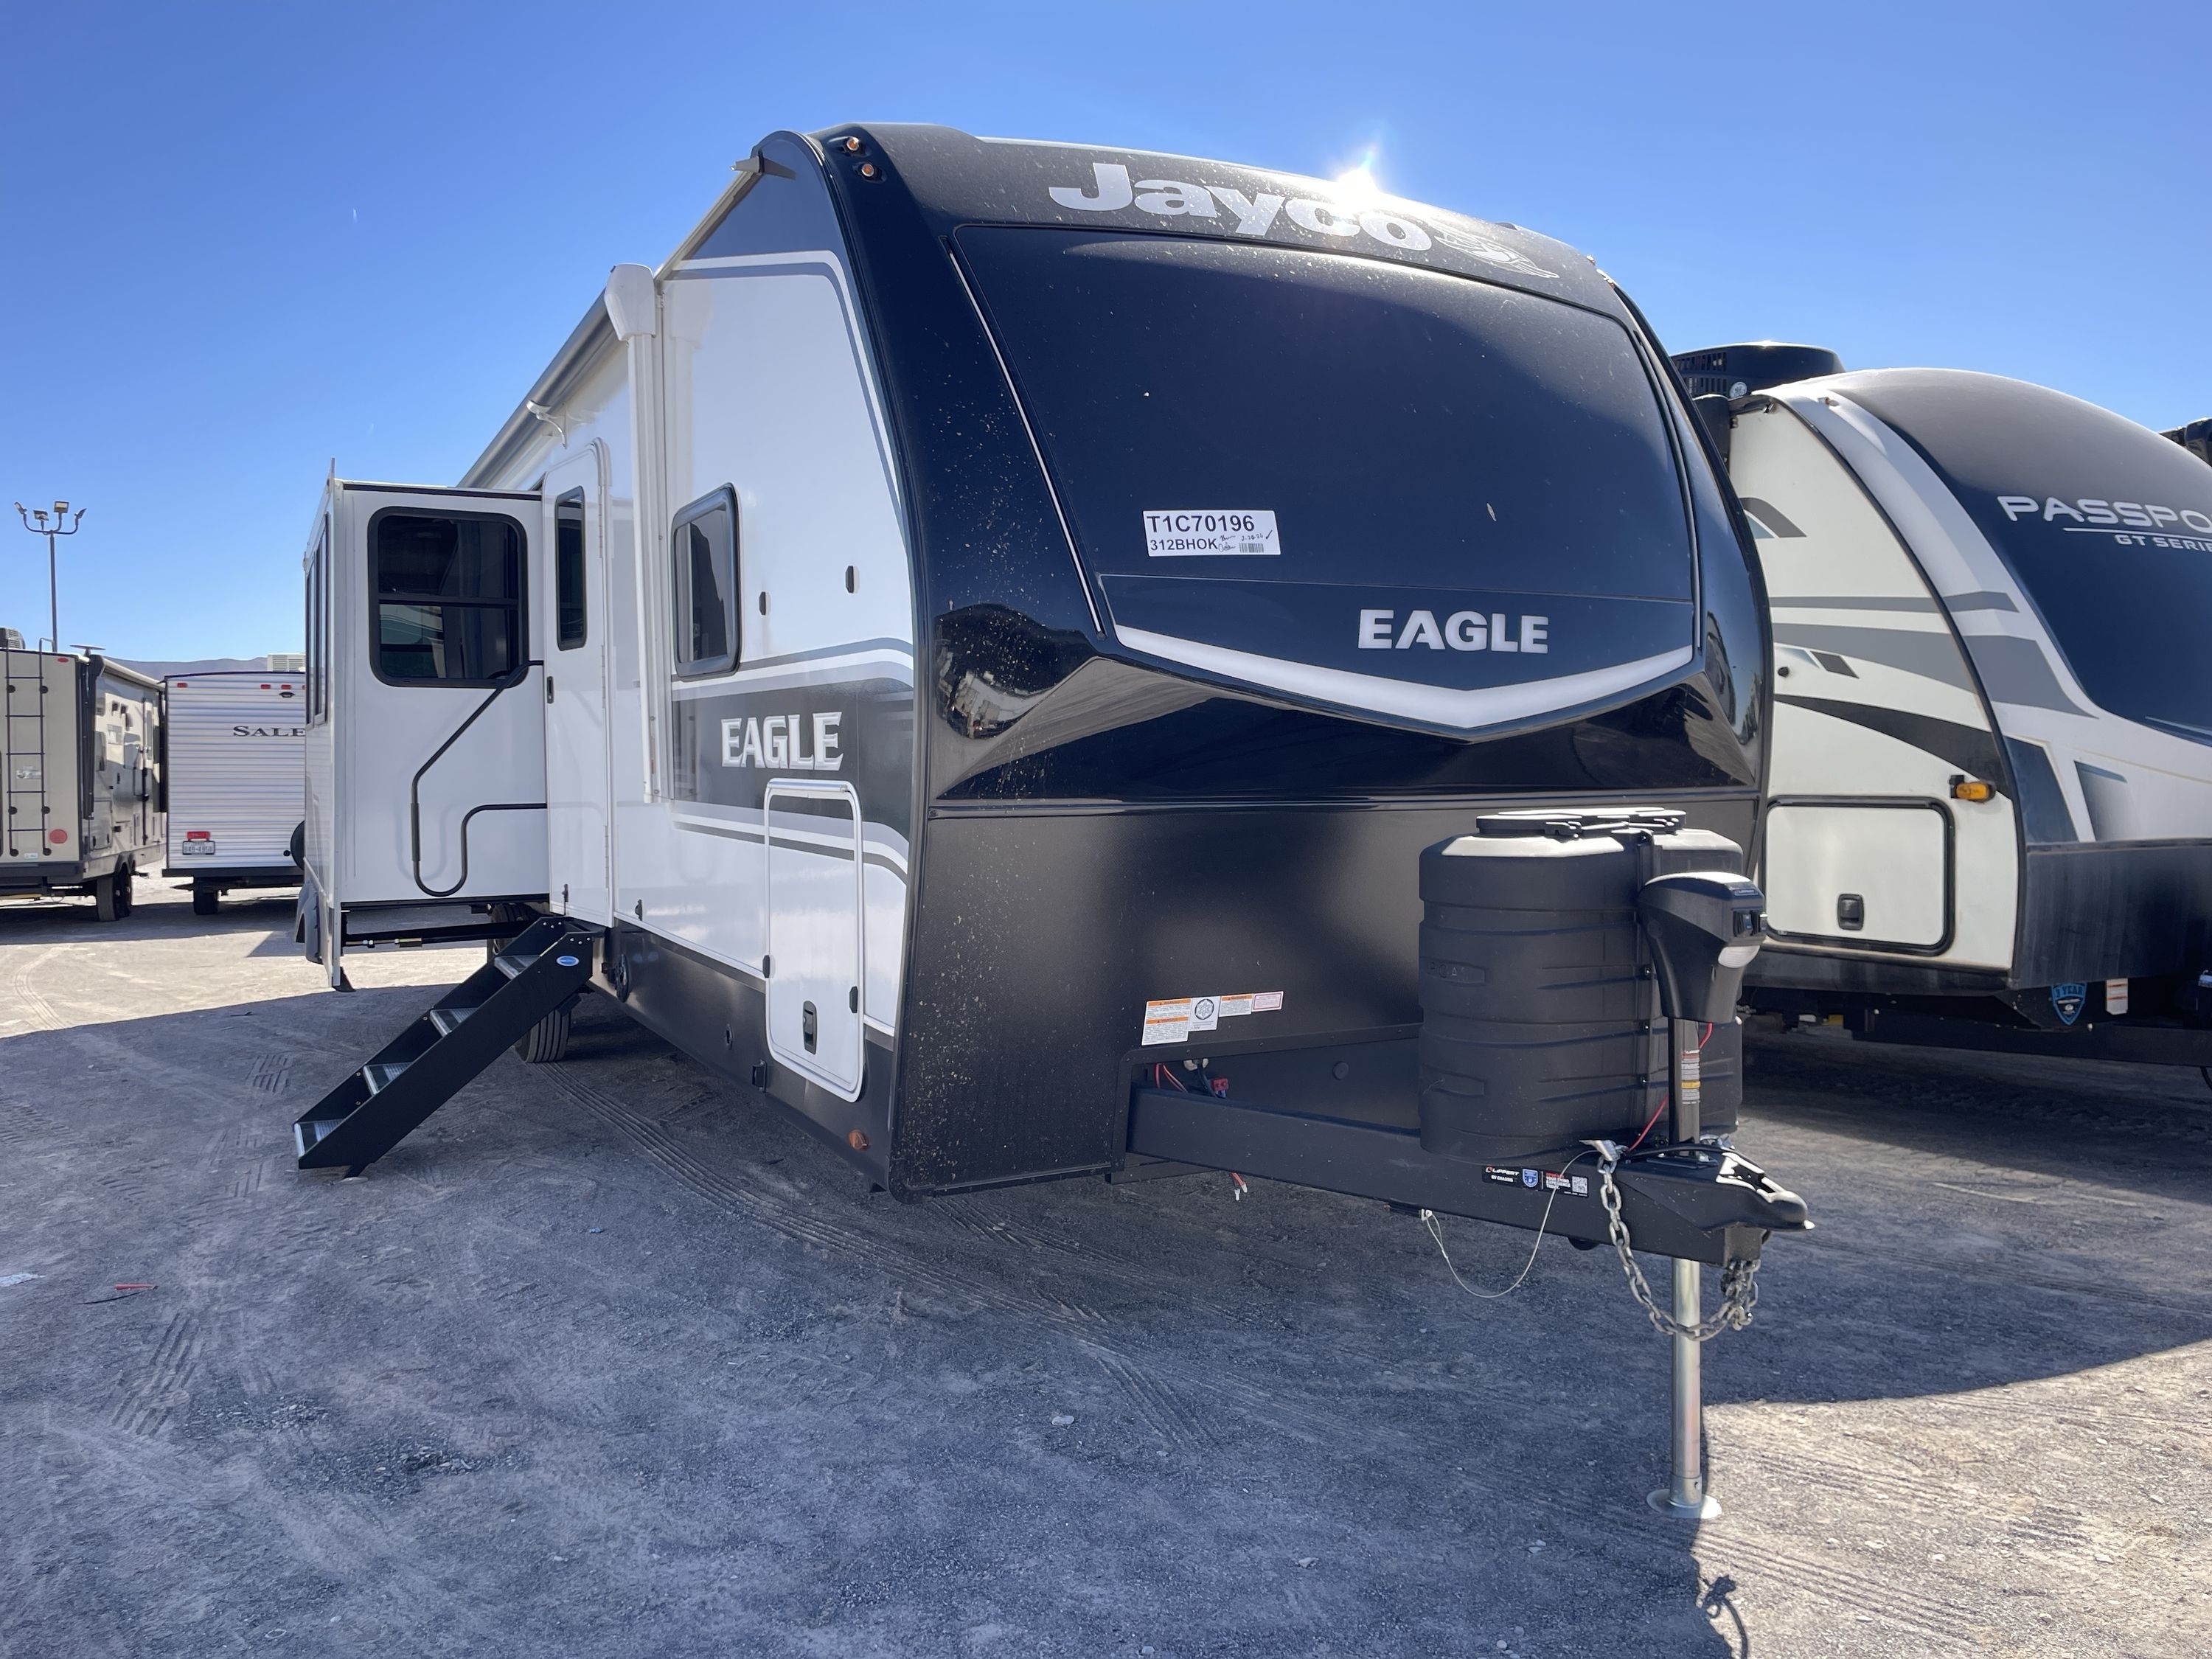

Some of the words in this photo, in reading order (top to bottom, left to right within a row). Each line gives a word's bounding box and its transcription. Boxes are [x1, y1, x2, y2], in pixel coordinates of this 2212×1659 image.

[1048, 161, 1431, 251] Jayco
[1146, 515, 1255, 532] T1C70196
[1150, 538, 1218, 551] 312BHOK
[2114, 533, 2146, 546] GT
[1357, 609, 1548, 654] EAGLE
[720, 712, 844, 771] EAGLE
